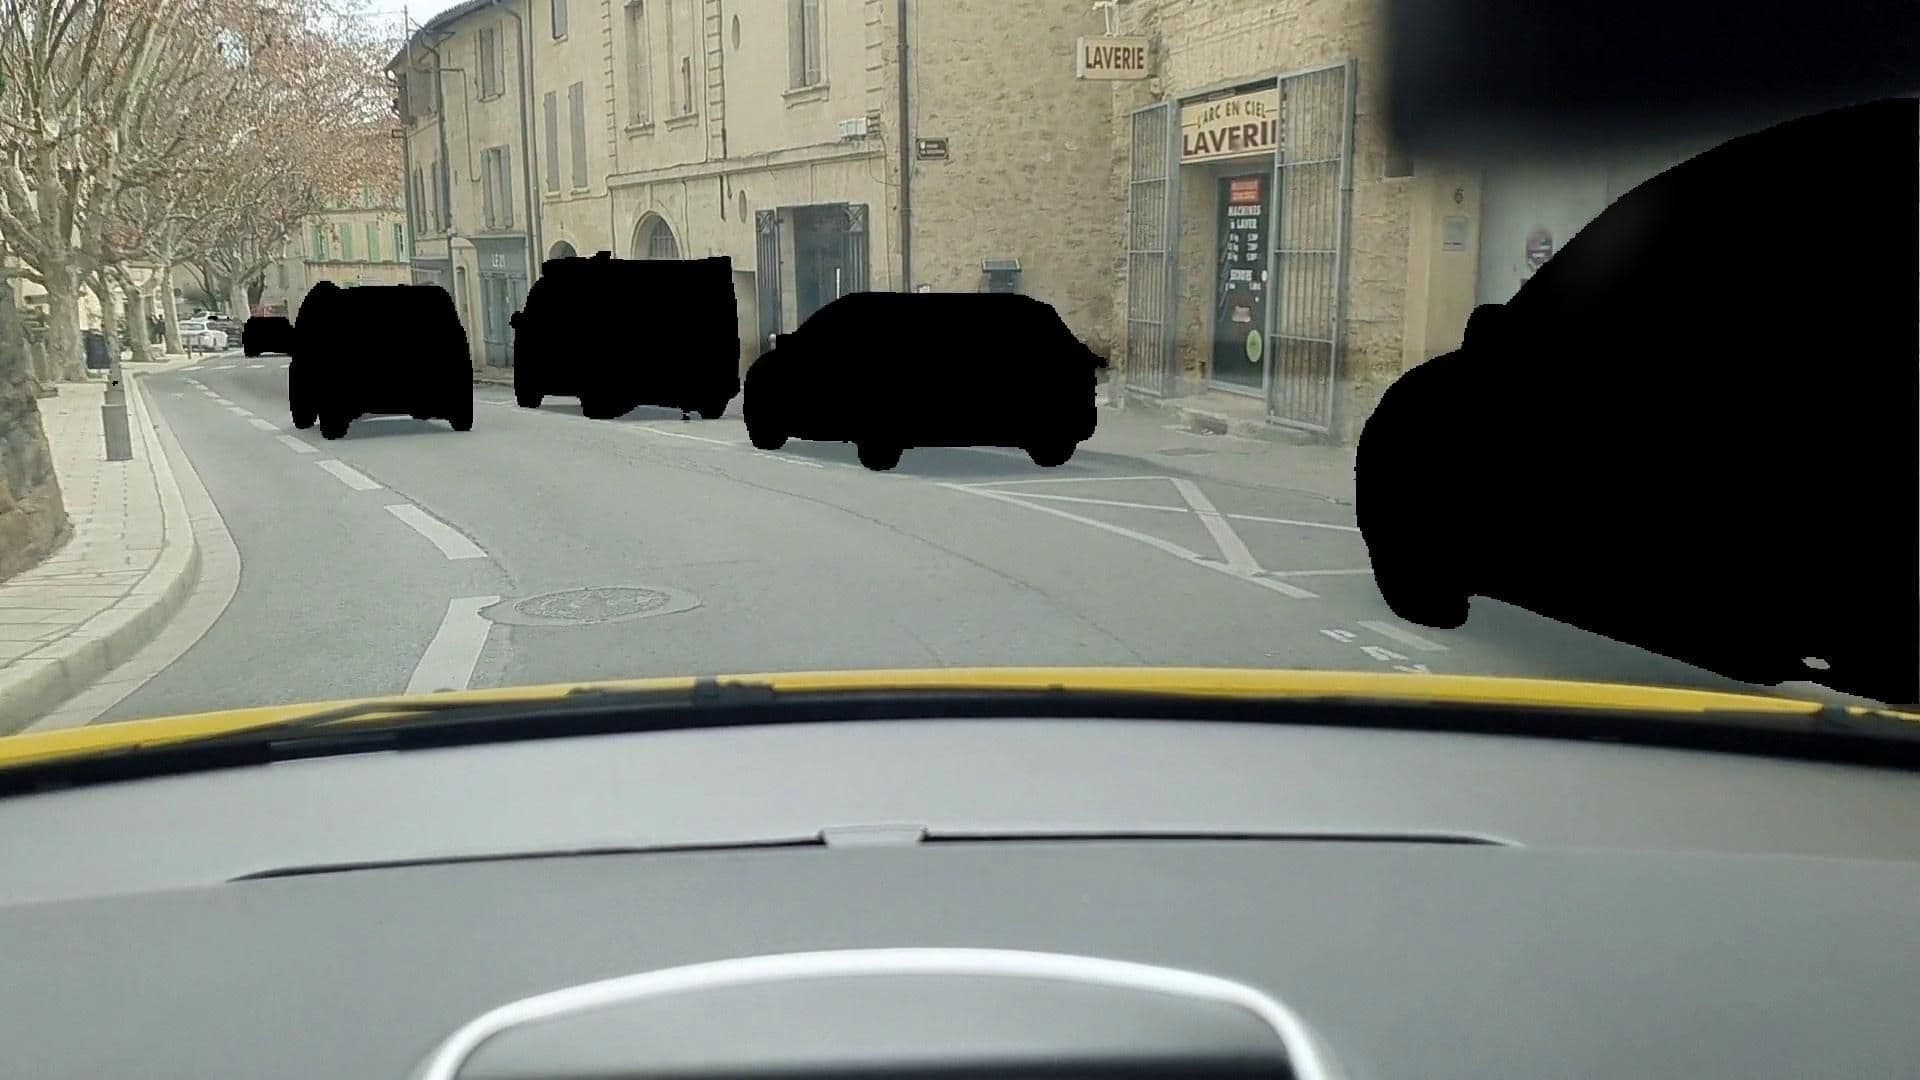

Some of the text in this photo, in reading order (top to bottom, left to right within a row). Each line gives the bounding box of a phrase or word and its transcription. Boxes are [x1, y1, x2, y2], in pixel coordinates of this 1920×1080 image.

[1085, 45, 1144, 70] LAVERIE
[1197, 100, 1266, 128] L'ARC EN CIEL
